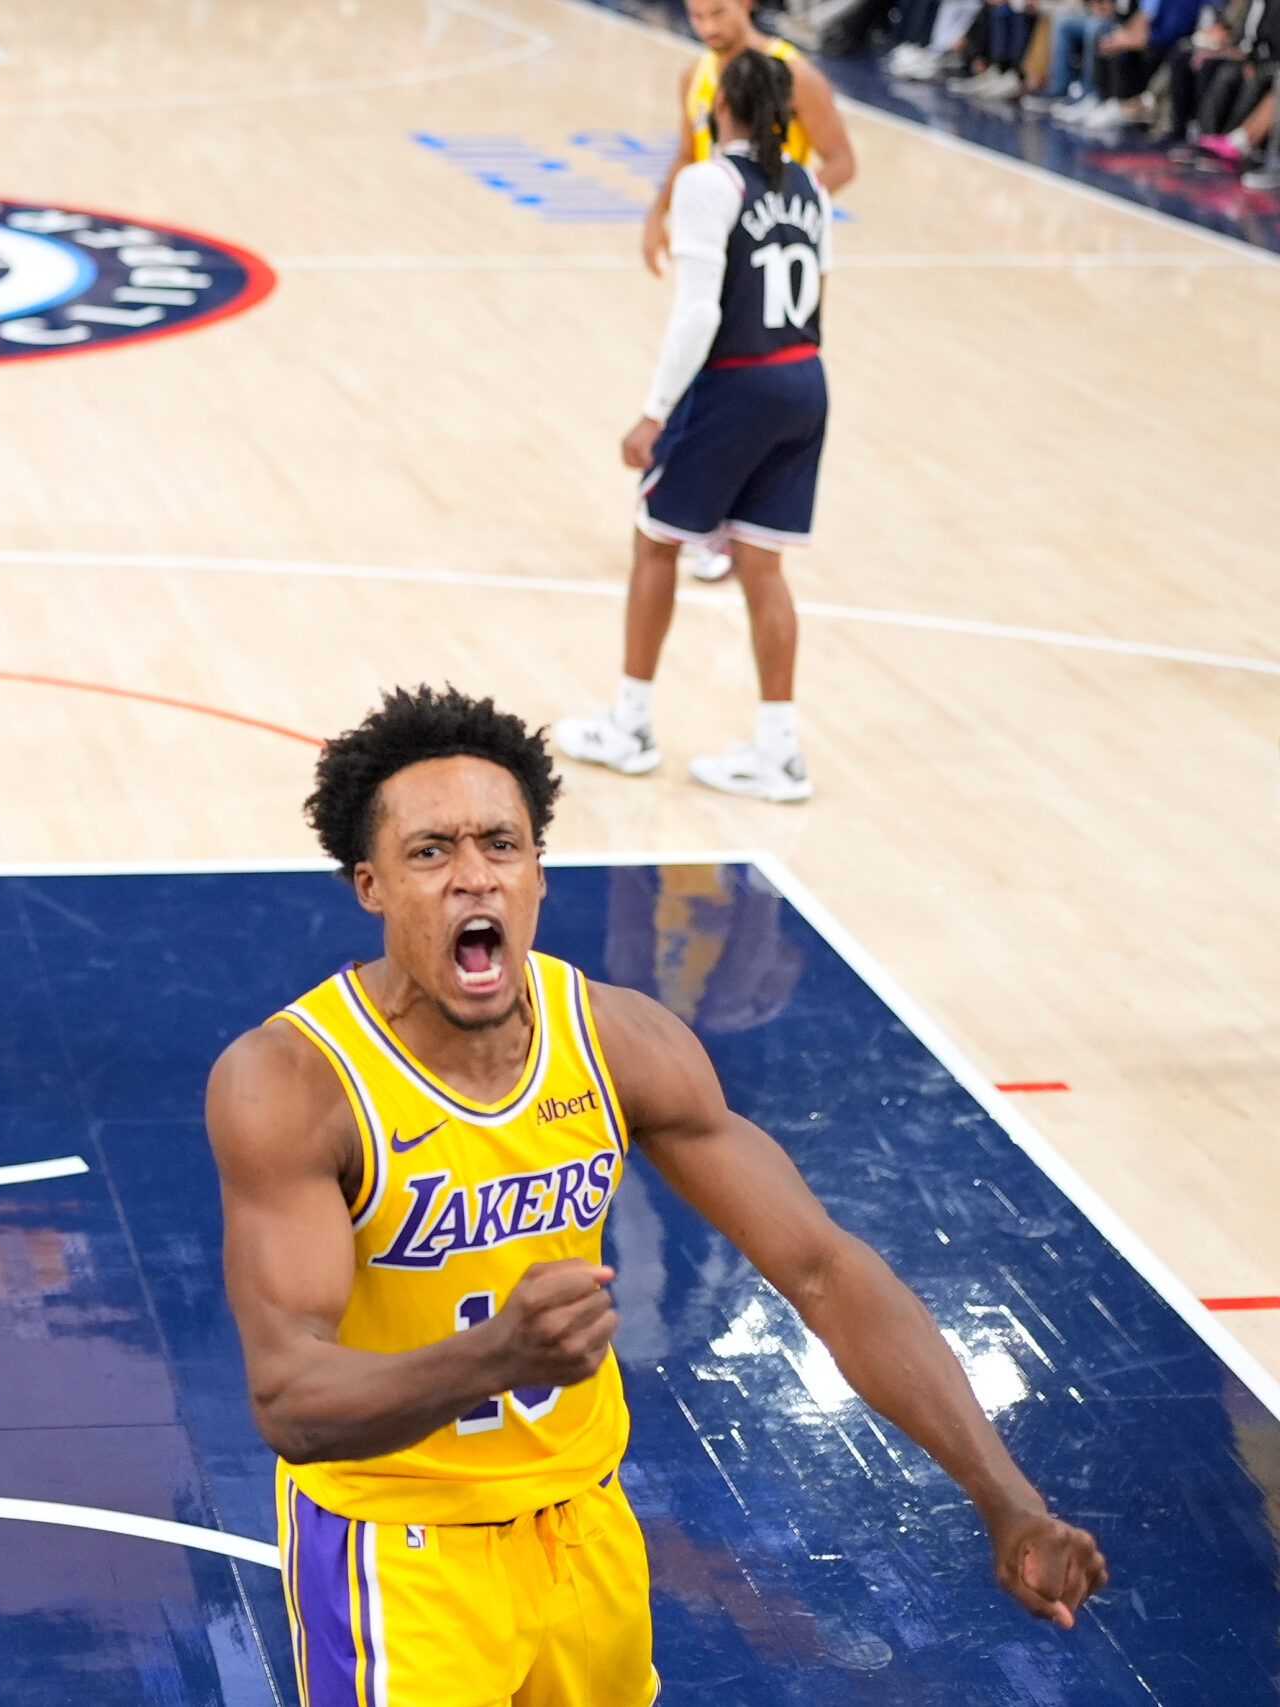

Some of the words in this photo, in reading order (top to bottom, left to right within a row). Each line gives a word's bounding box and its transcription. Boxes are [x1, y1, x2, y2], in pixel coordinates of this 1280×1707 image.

[749, 242, 821, 329] 10
[536, 1089, 600, 1126] Albert
[368, 1149, 620, 1272] LAKERS
